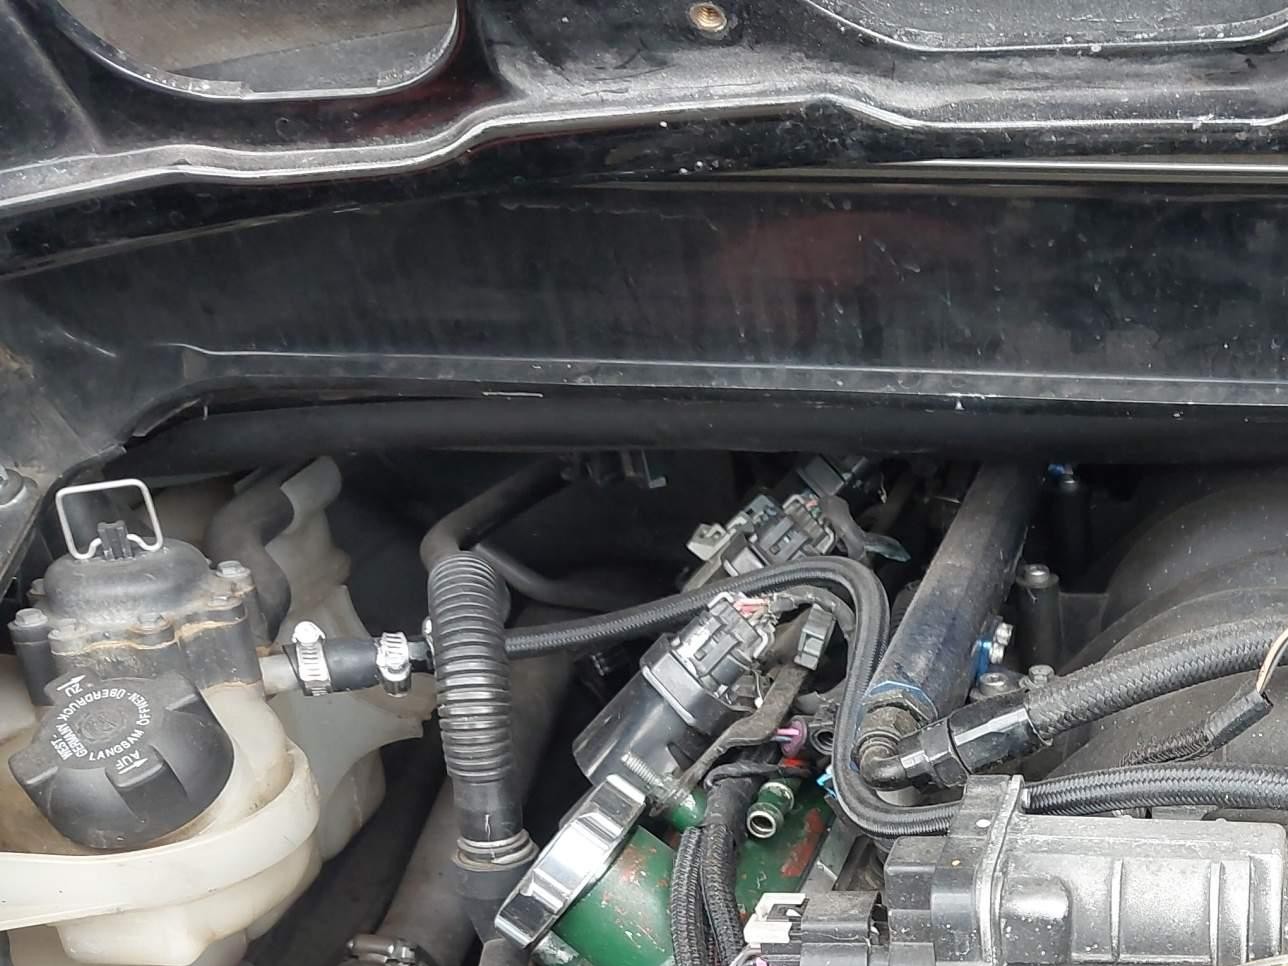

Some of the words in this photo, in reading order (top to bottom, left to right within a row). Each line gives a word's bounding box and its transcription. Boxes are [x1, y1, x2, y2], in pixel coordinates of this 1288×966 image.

[65, 683, 83, 697] ZU
[56, 723, 88, 757] GERMANY
[89, 729, 144, 760] LANGSAM
[116, 750, 140, 770] AUF
